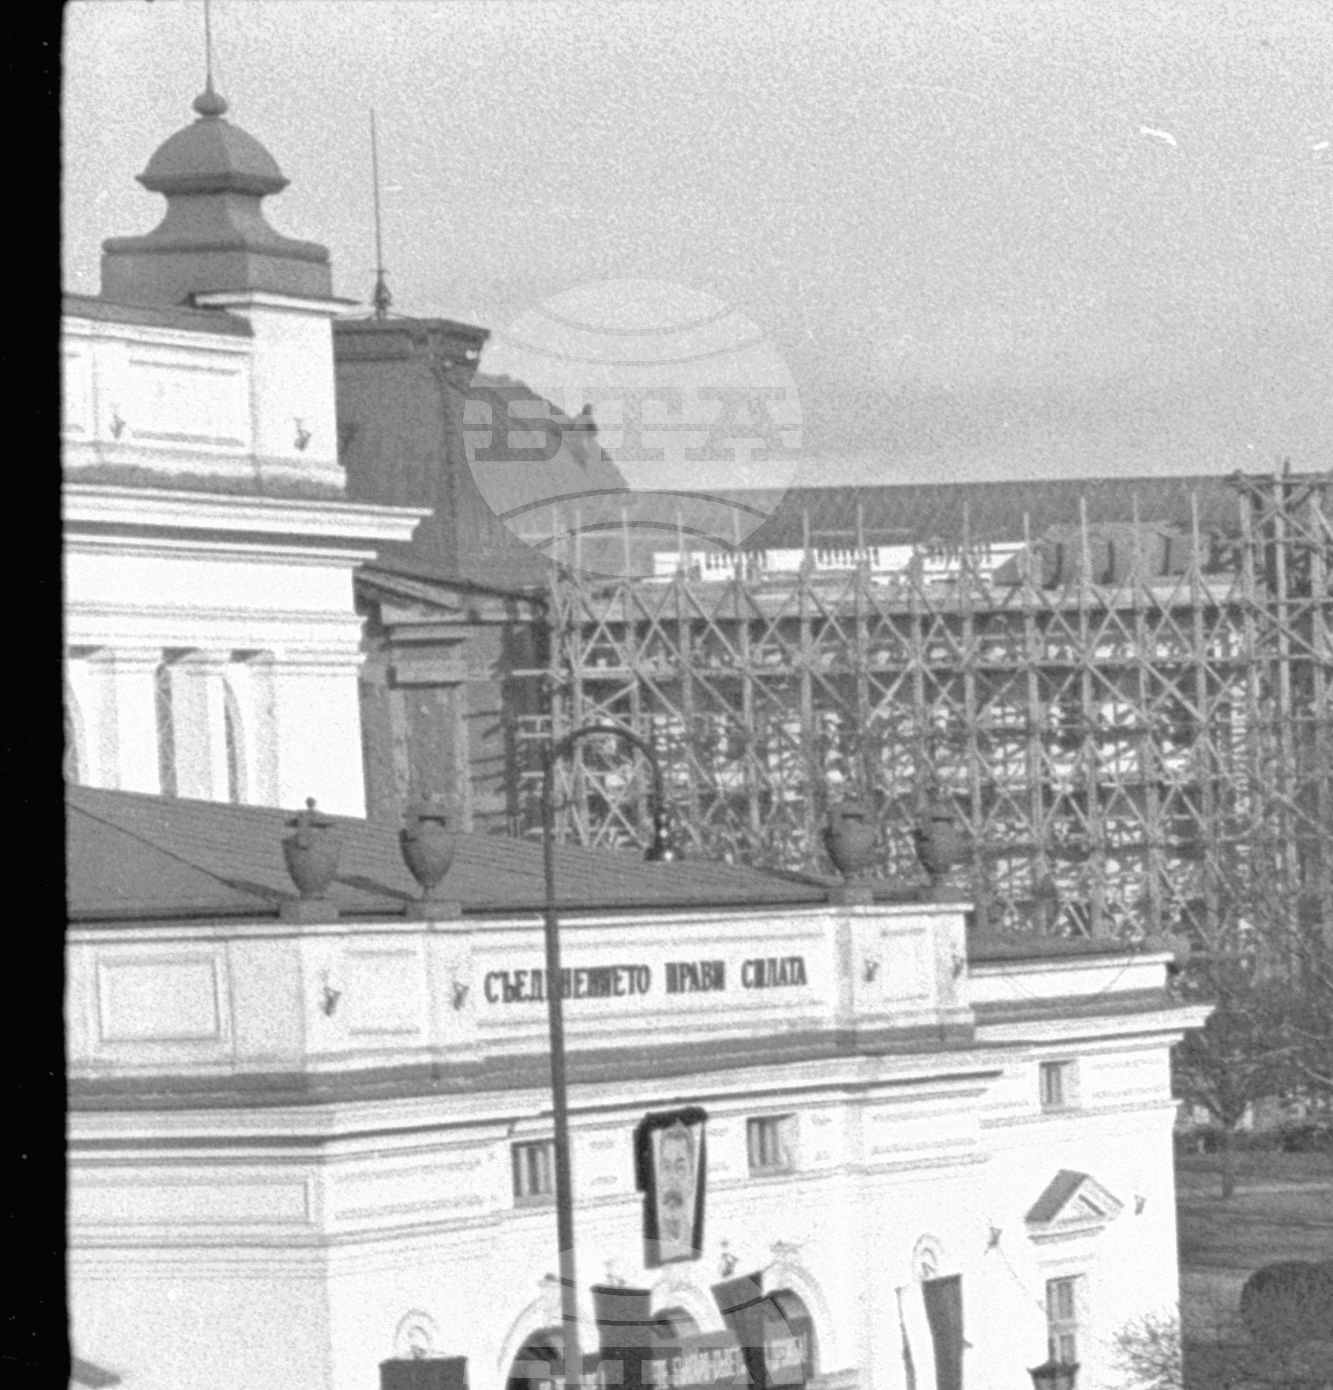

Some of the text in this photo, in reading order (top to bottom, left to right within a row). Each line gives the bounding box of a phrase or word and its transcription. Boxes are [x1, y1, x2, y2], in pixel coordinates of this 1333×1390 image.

[483, 955, 808, 1004] СЪЕДНЕНИЕТО ПРАВИ СИЛАТА
